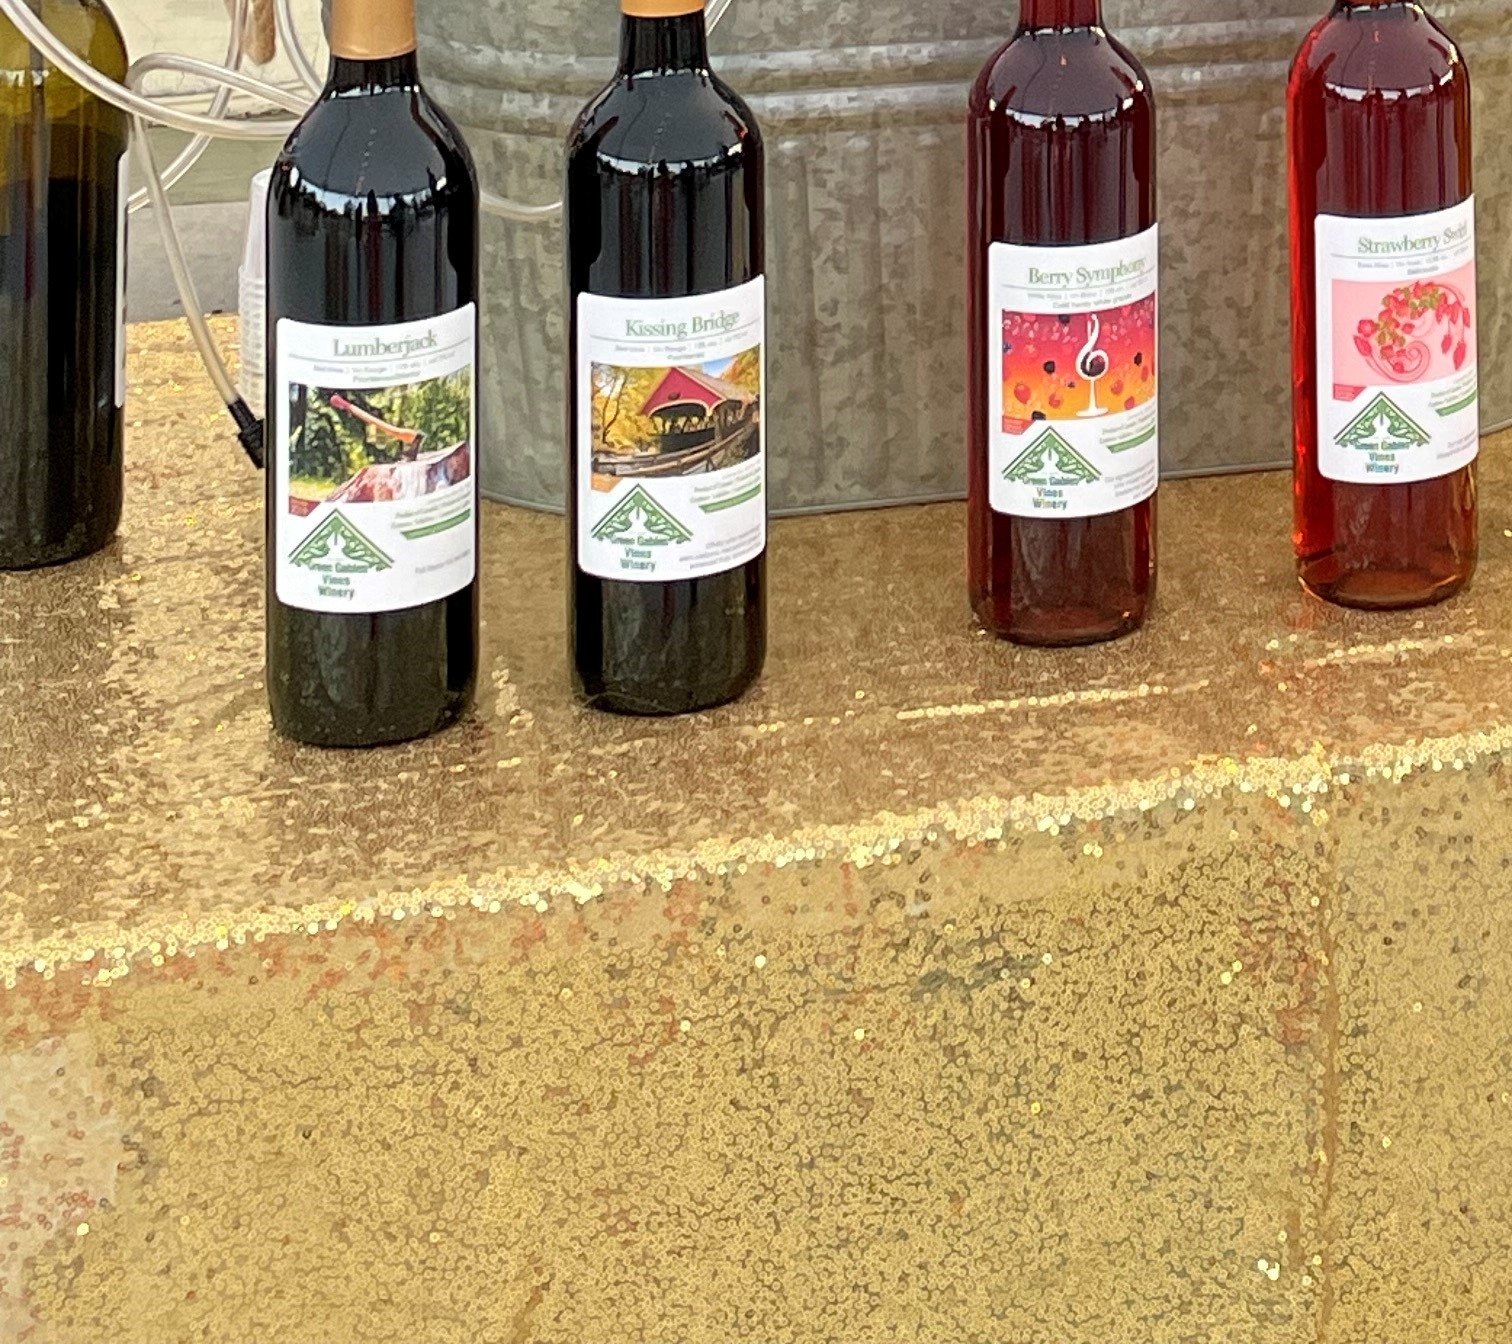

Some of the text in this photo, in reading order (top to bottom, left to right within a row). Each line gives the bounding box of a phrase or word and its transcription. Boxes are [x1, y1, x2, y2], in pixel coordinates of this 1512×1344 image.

[1357, 234, 1441, 255] Strawberry
[1028, 257, 1146, 289] Berry Symphony
[625, 309, 740, 340] Kissing Bridge
[332, 329, 439, 358] Lumberjack
[322, 574, 351, 586] Vines
[317, 585, 355, 601] Winery
